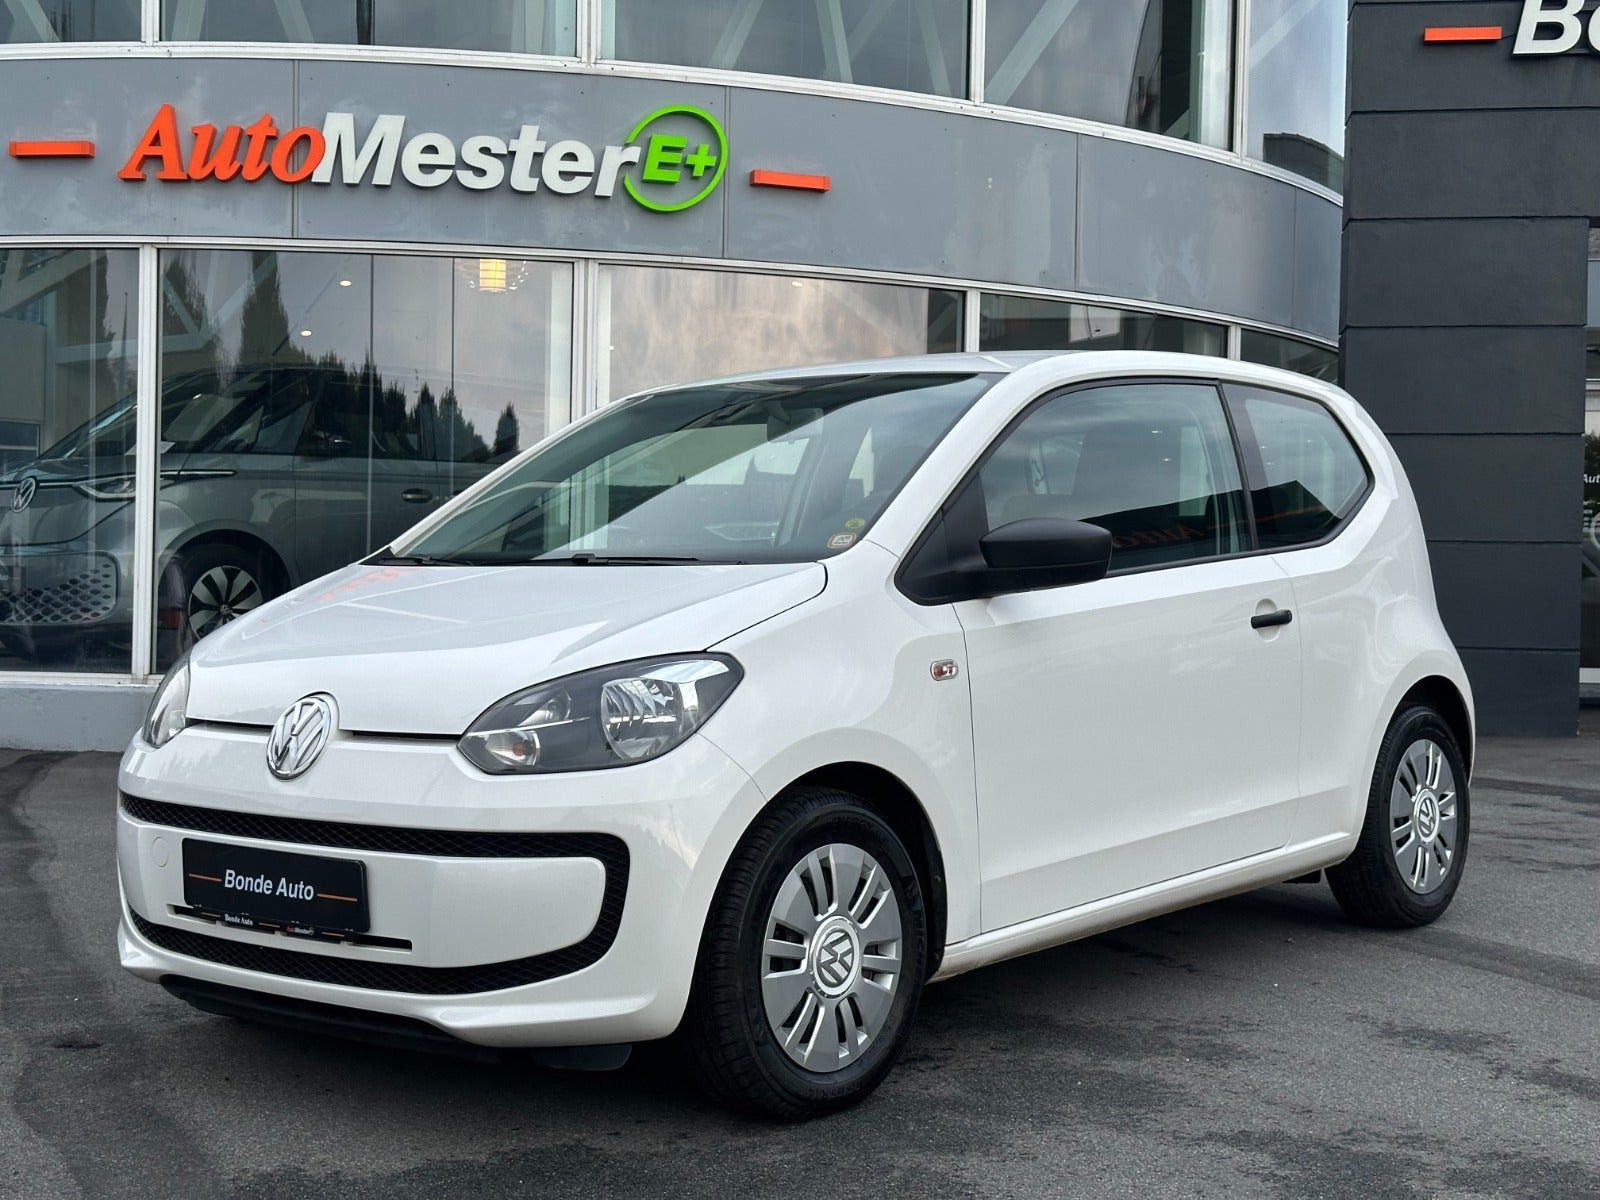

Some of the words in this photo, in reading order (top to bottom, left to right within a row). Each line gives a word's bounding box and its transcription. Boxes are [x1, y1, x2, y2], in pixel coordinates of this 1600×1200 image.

[1513, 0, 1600, 55] B
[224, 869, 273, 895] Bonde
[276, 877, 314, 901] Auto
